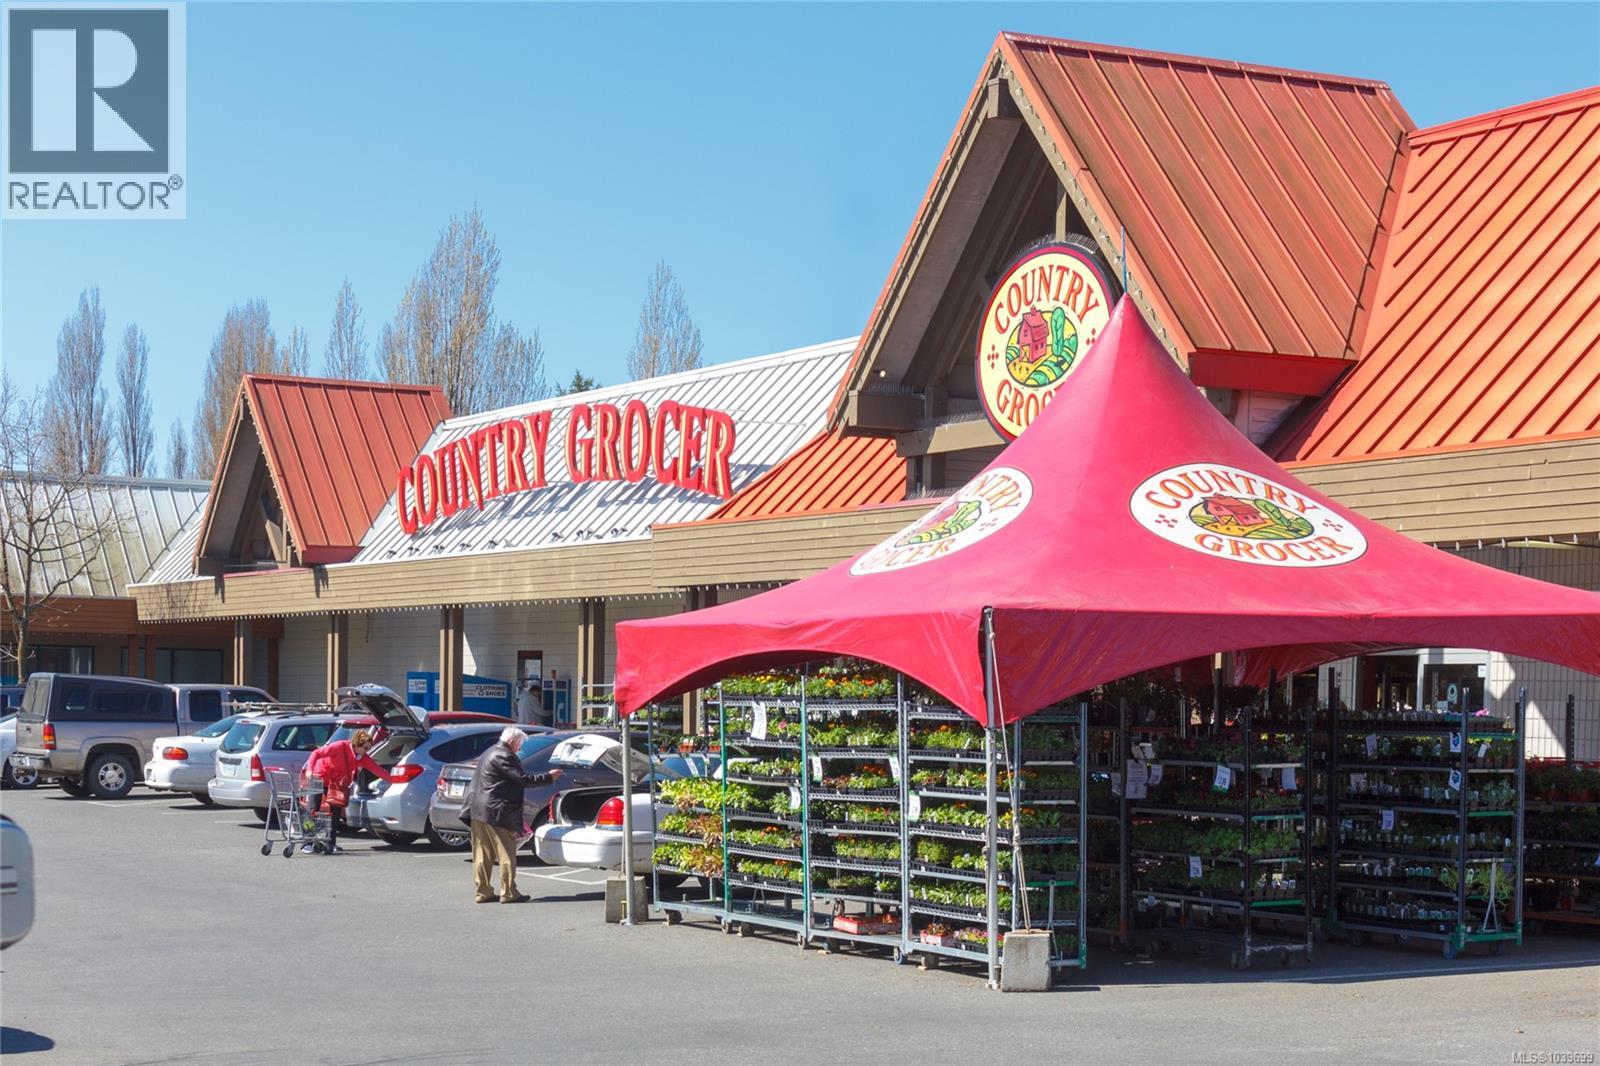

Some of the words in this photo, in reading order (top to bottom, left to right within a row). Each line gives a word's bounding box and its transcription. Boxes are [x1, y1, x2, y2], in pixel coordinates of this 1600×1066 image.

[994, 264, 1100, 335] COUNTRY
[396, 410, 553, 535] COUNTRY
[564, 400, 736, 500] GROCER
[1144, 469, 1317, 515] COUNTRY
[1193, 532, 1354, 562] GROCER
